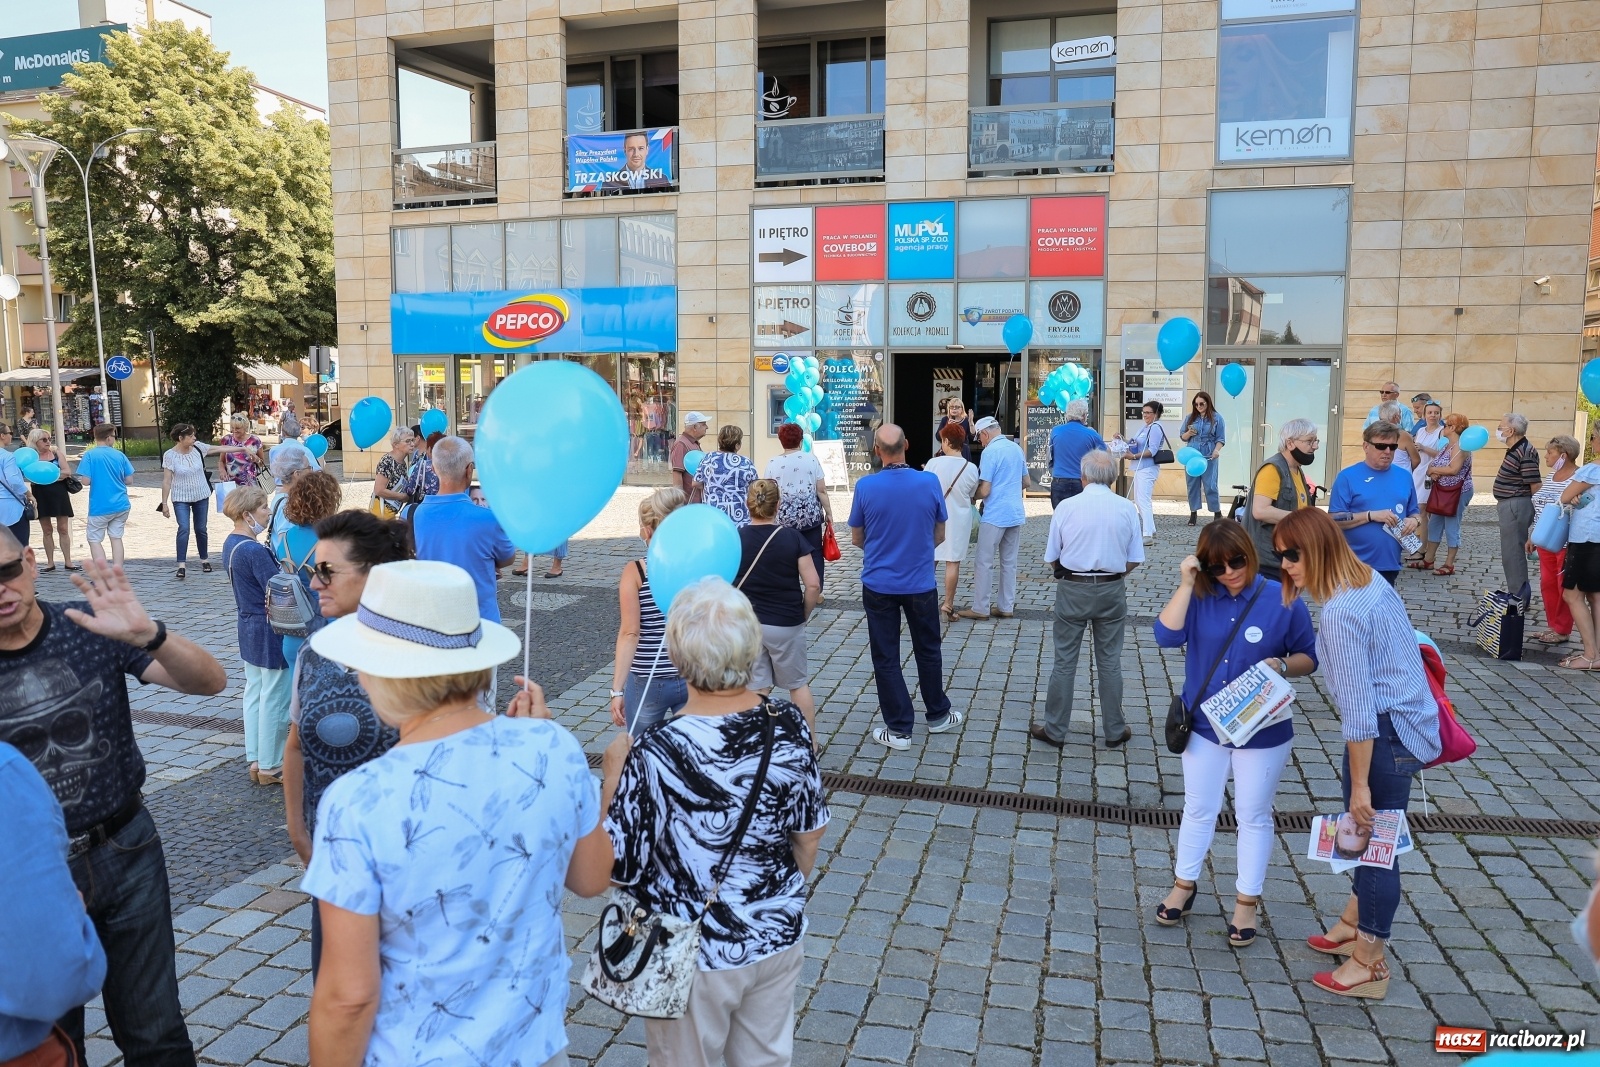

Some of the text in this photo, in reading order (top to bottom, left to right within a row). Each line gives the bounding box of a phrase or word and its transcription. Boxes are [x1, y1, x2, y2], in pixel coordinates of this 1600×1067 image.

[14, 49, 90, 71] McDonald's
[589, 148, 617, 156] Prezydent
[574, 168, 663, 184] TRZASKOWSKI
[759, 226, 809, 240] II PIĘTRO
[894, 222, 949, 237] MUPOL
[823, 243, 866, 253] COVEBO
[894, 244, 949, 252] agencja pracy
[1037, 236, 1085, 247] COVEBO
[765, 297, 810, 312] PIĘTRO
[495, 312, 554, 330] PEPCO
[892, 326, 949, 337] KOLEKCJA PROMILI
[822, 365, 875, 374] POLECAMY
[1204, 684, 1233, 712] NOWY
[1210, 668, 1266, 721] PREZYDENT
